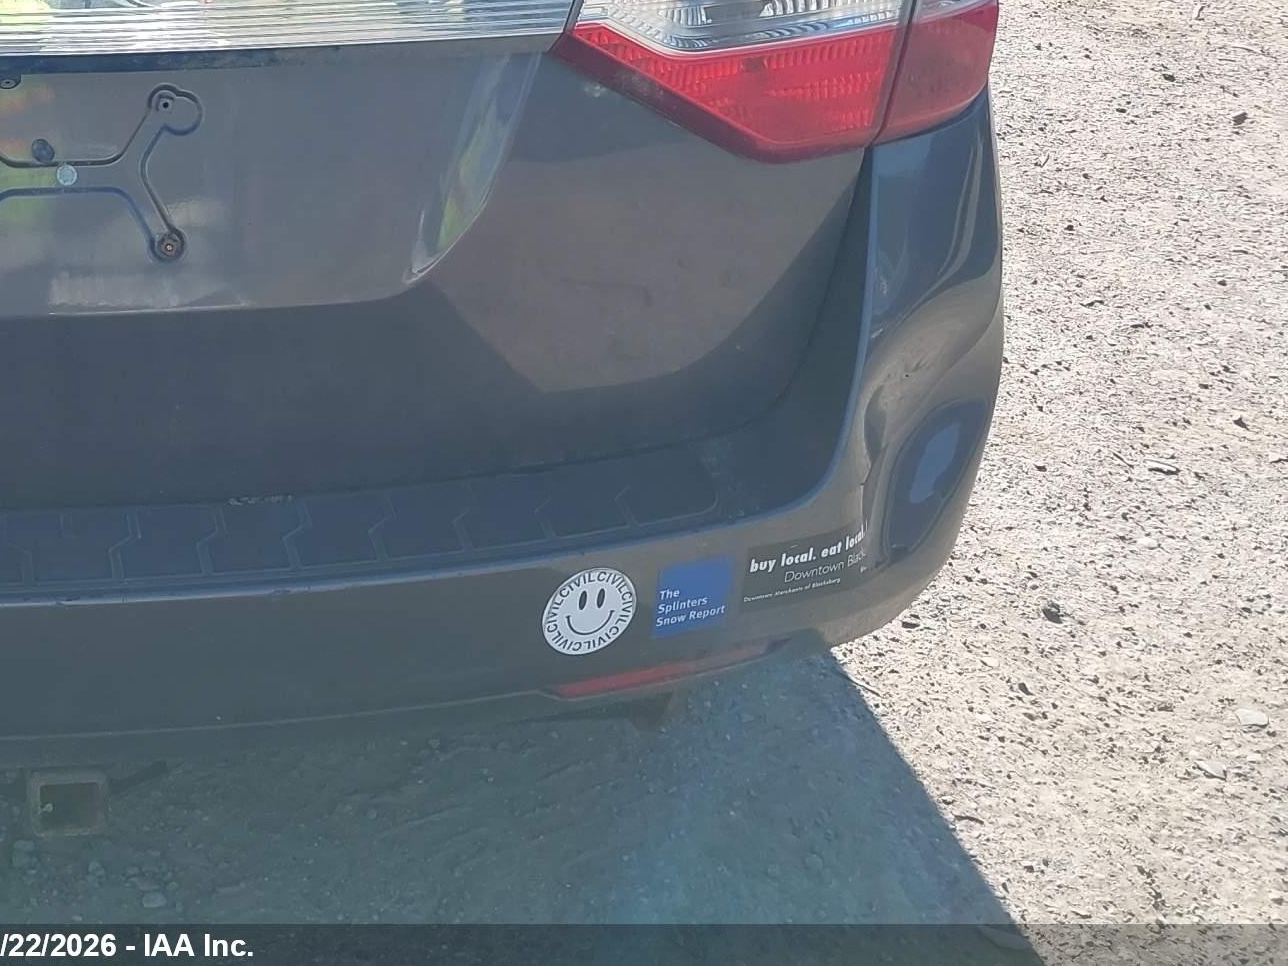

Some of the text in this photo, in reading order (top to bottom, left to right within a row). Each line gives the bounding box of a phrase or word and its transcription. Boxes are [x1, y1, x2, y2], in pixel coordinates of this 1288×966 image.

[749, 557, 777, 573] buy
[780, 546, 817, 567] local.
[821, 540, 843, 558] eat
[784, 560, 845, 584] Downtown
[657, 596, 709, 615] Splinters
[659, 588, 681, 601] The
[655, 604, 726, 627] Snow Report
